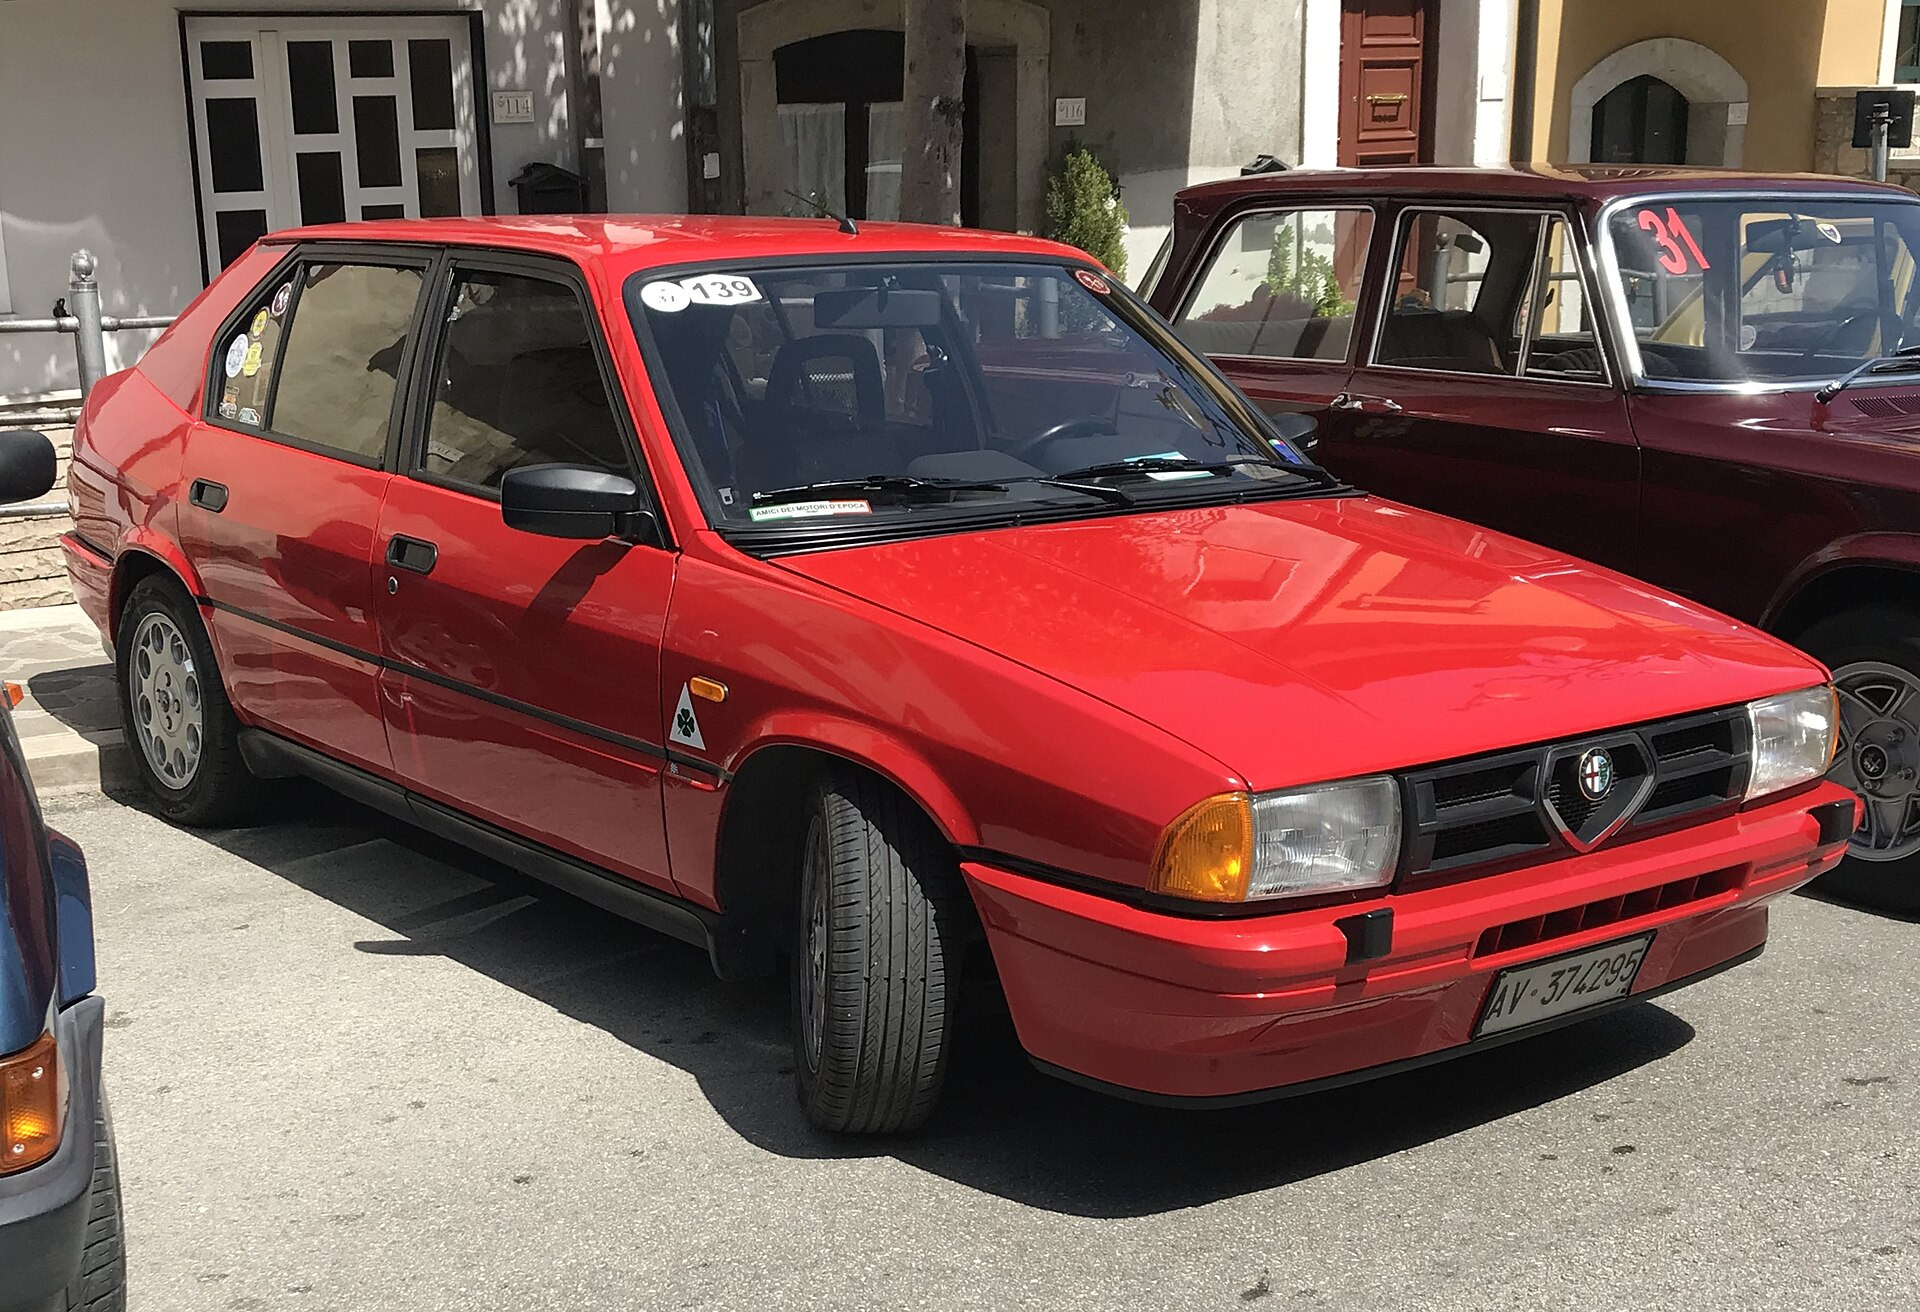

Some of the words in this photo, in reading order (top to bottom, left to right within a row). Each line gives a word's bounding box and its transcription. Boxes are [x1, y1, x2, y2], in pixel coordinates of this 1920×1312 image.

[506, 99, 530, 114] 114
[1065, 104, 1083, 118] 116
[1638, 207, 1711, 275] 31
[692, 280, 753, 299] 139
[755, 509, 780, 517] AMICI
